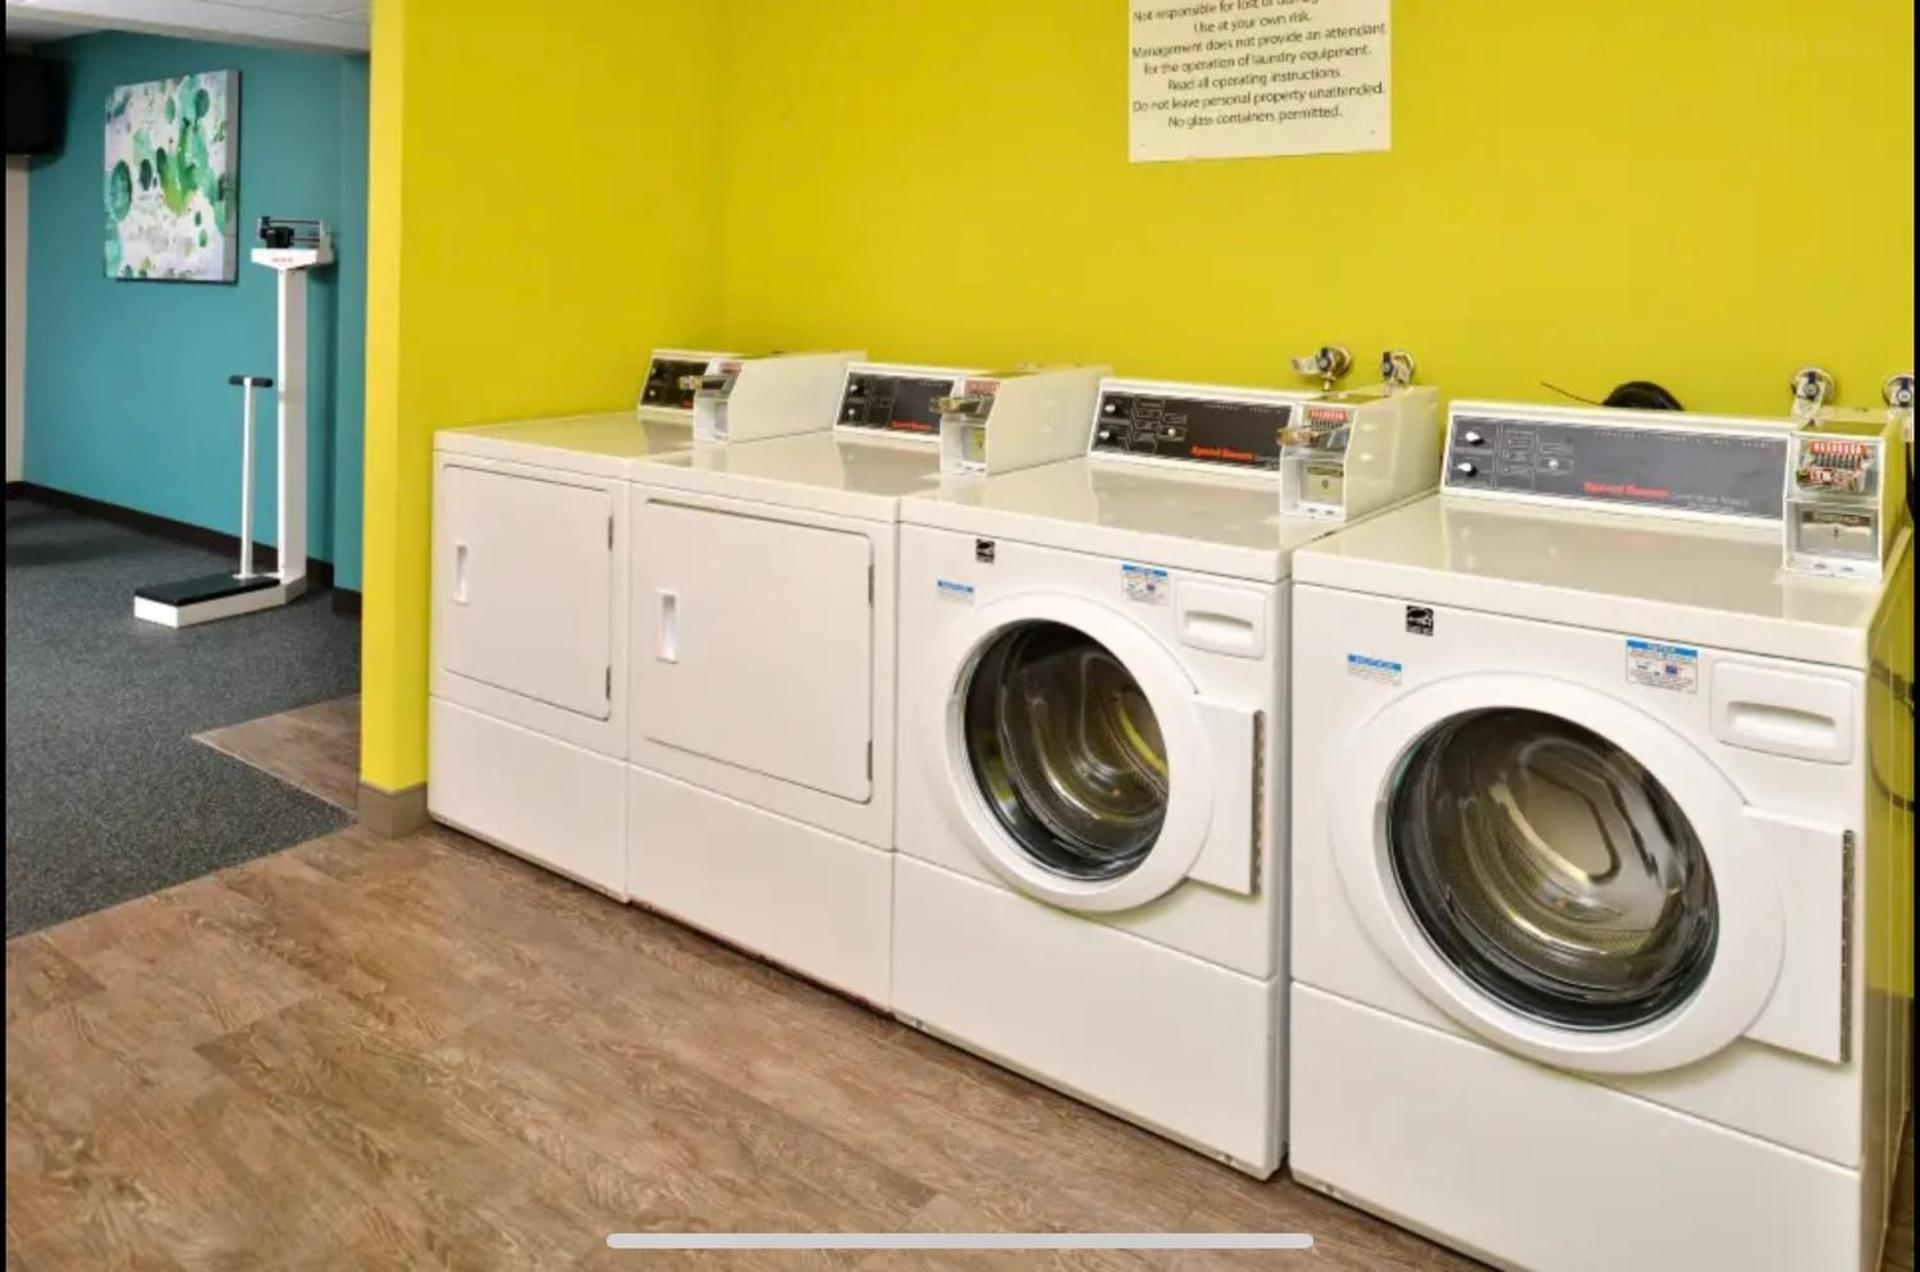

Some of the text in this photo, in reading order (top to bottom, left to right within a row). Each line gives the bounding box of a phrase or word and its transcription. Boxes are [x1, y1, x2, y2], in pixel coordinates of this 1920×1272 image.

[1194, 21, 1215, 33] Use
[1218, 20, 1229, 31] at
[1231, 18, 1256, 32] your
[1259, 15, 1287, 27] own
[1132, 23, 1385, 58] Management does not provide an attendant
[1144, 63, 1159, 75] for
[1161, 61, 1179, 74] the
[1182, 57, 1235, 73] operation
[1238, 53, 1250, 66] of
[1252, 52, 1297, 65] laundry
[1168, 78, 1194, 91] Read
[1198, 76, 1209, 89] all
[1212, 73, 1267, 89] operating
[1132, 100, 1149, 113] Do
[1151, 99, 1169, 110] not
[1171, 97, 1200, 109] leave
[1202, 91, 1251, 108] personal
[1253, 90, 1305, 106] property
[1168, 116, 1184, 128] No
[1187, 113, 1214, 129] glass
[1216, 111, 1275, 125] containers
